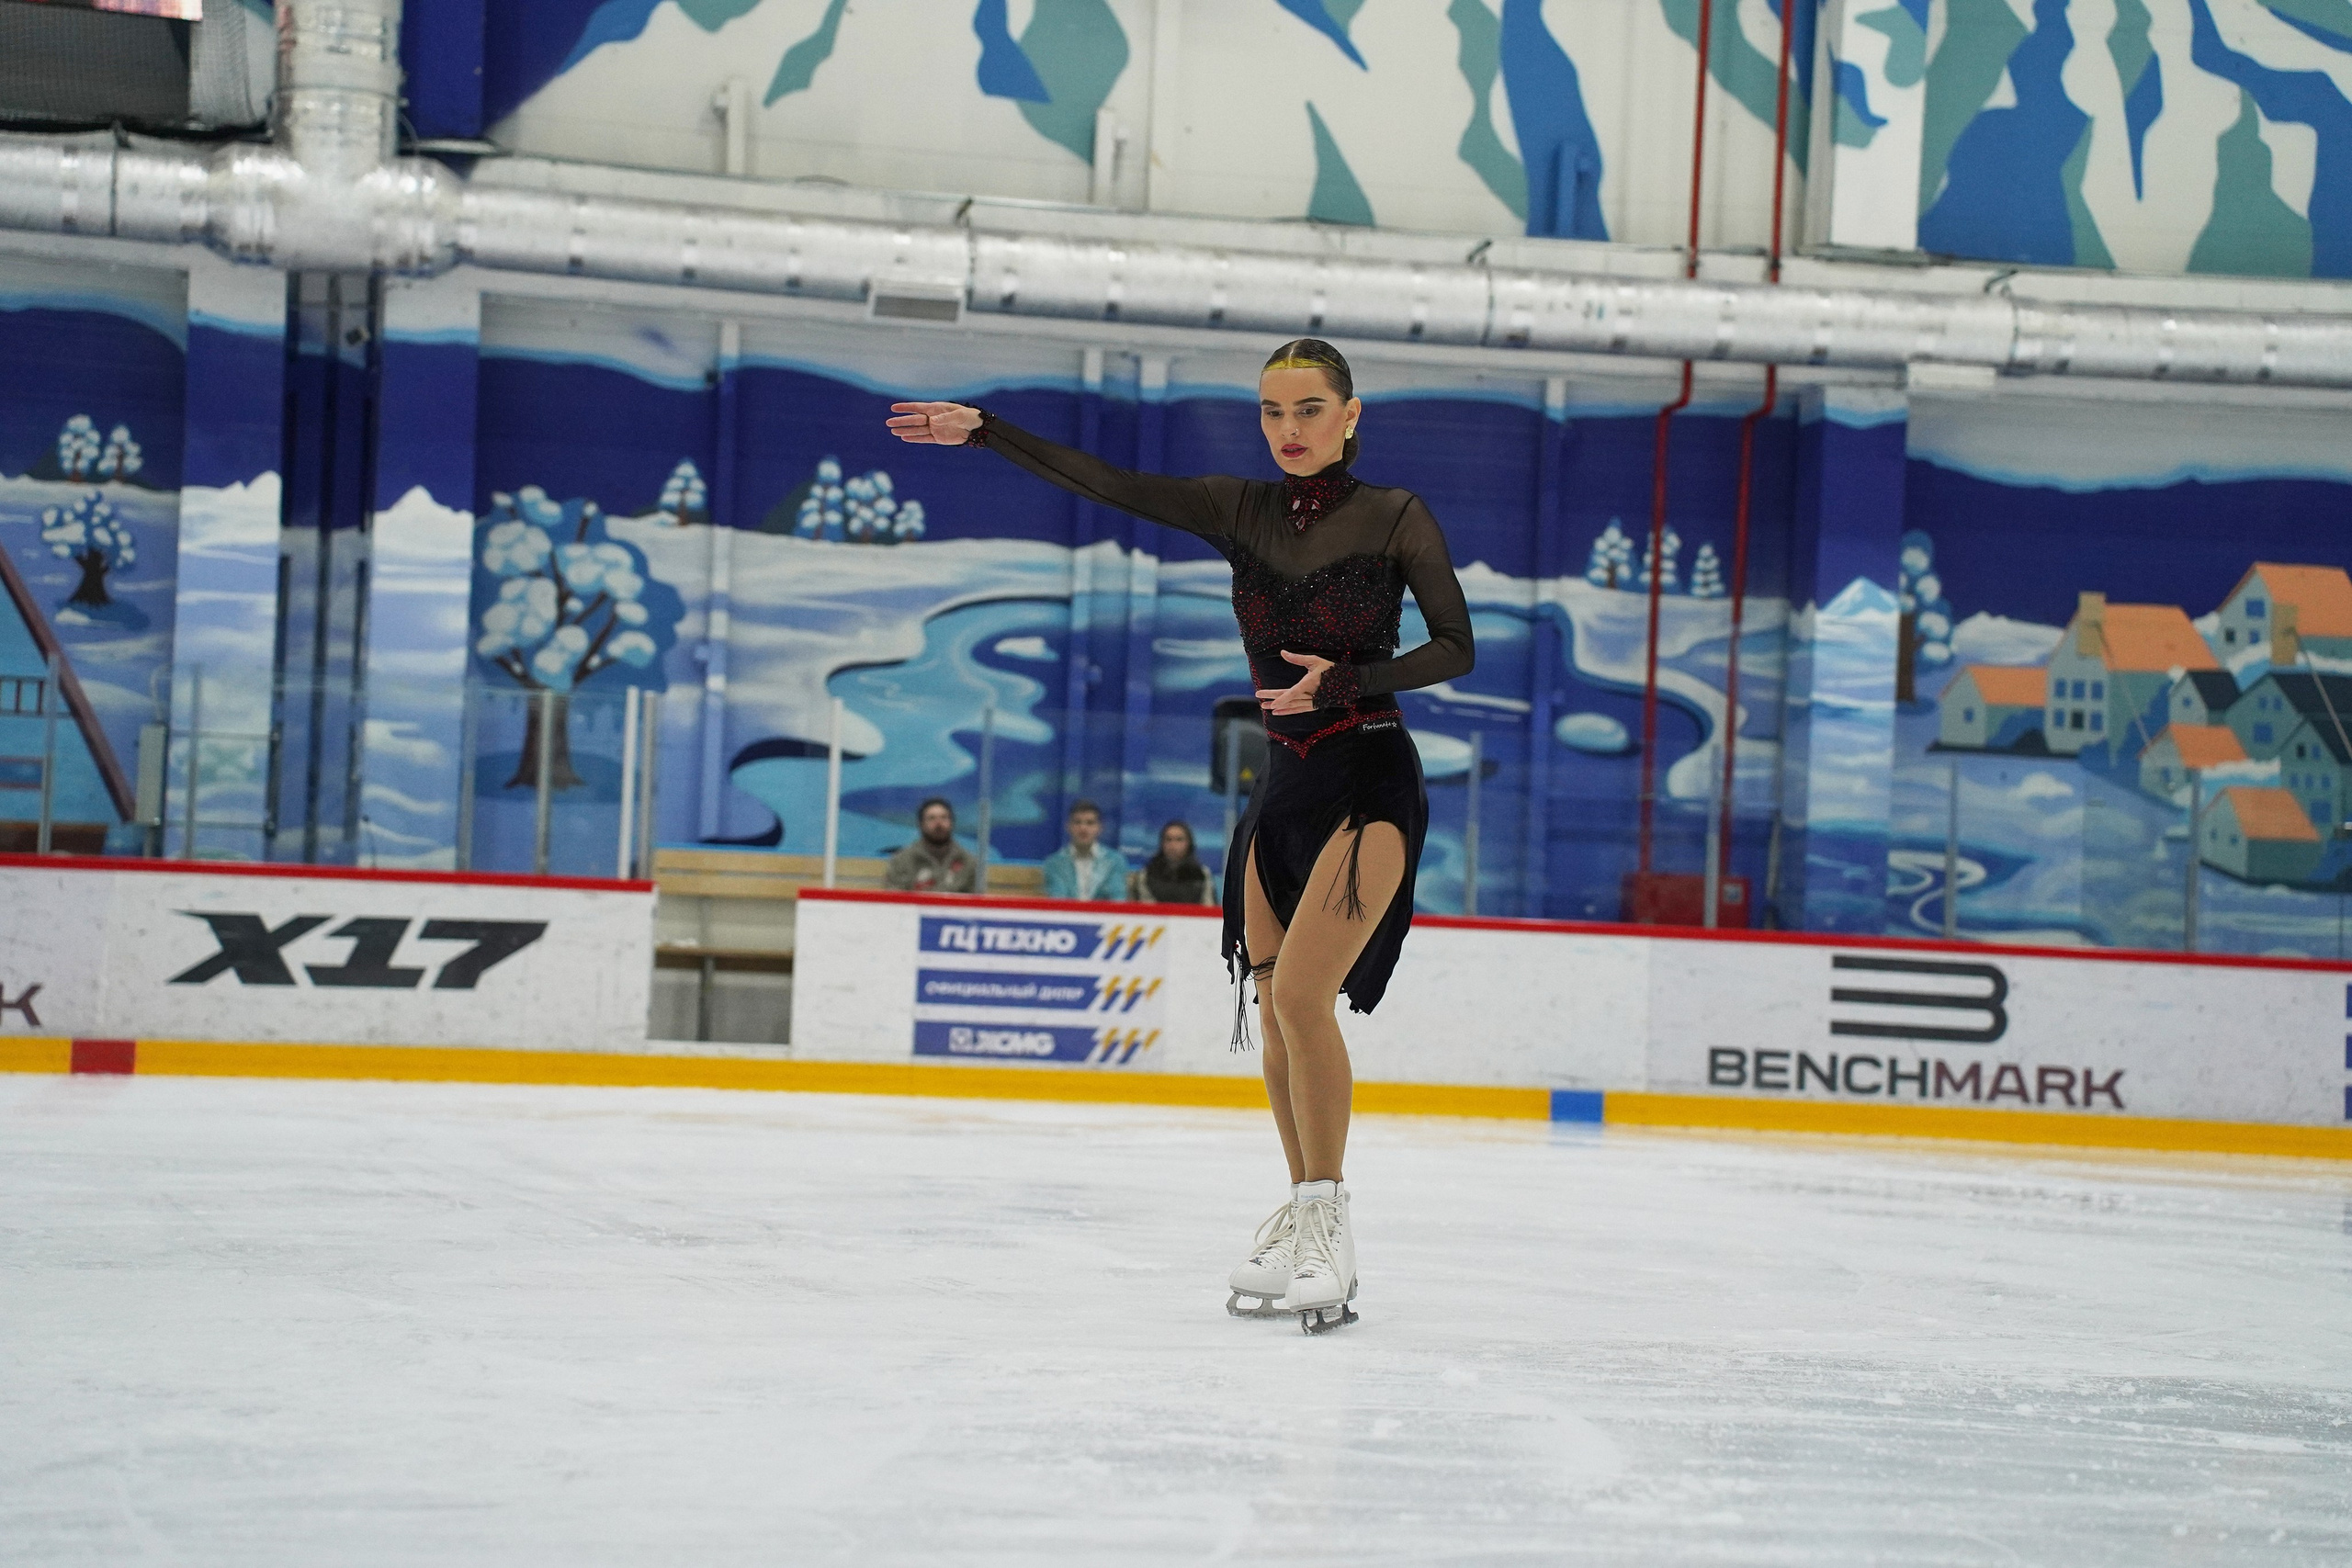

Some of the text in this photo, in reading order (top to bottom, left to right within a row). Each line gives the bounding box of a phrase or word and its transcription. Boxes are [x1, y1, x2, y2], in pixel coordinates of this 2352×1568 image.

[165, 908, 548, 989] X17
[982, 927, 1078, 953] ТЕХНО
[1708, 1047, 2125, 1110] BENCHMARK
